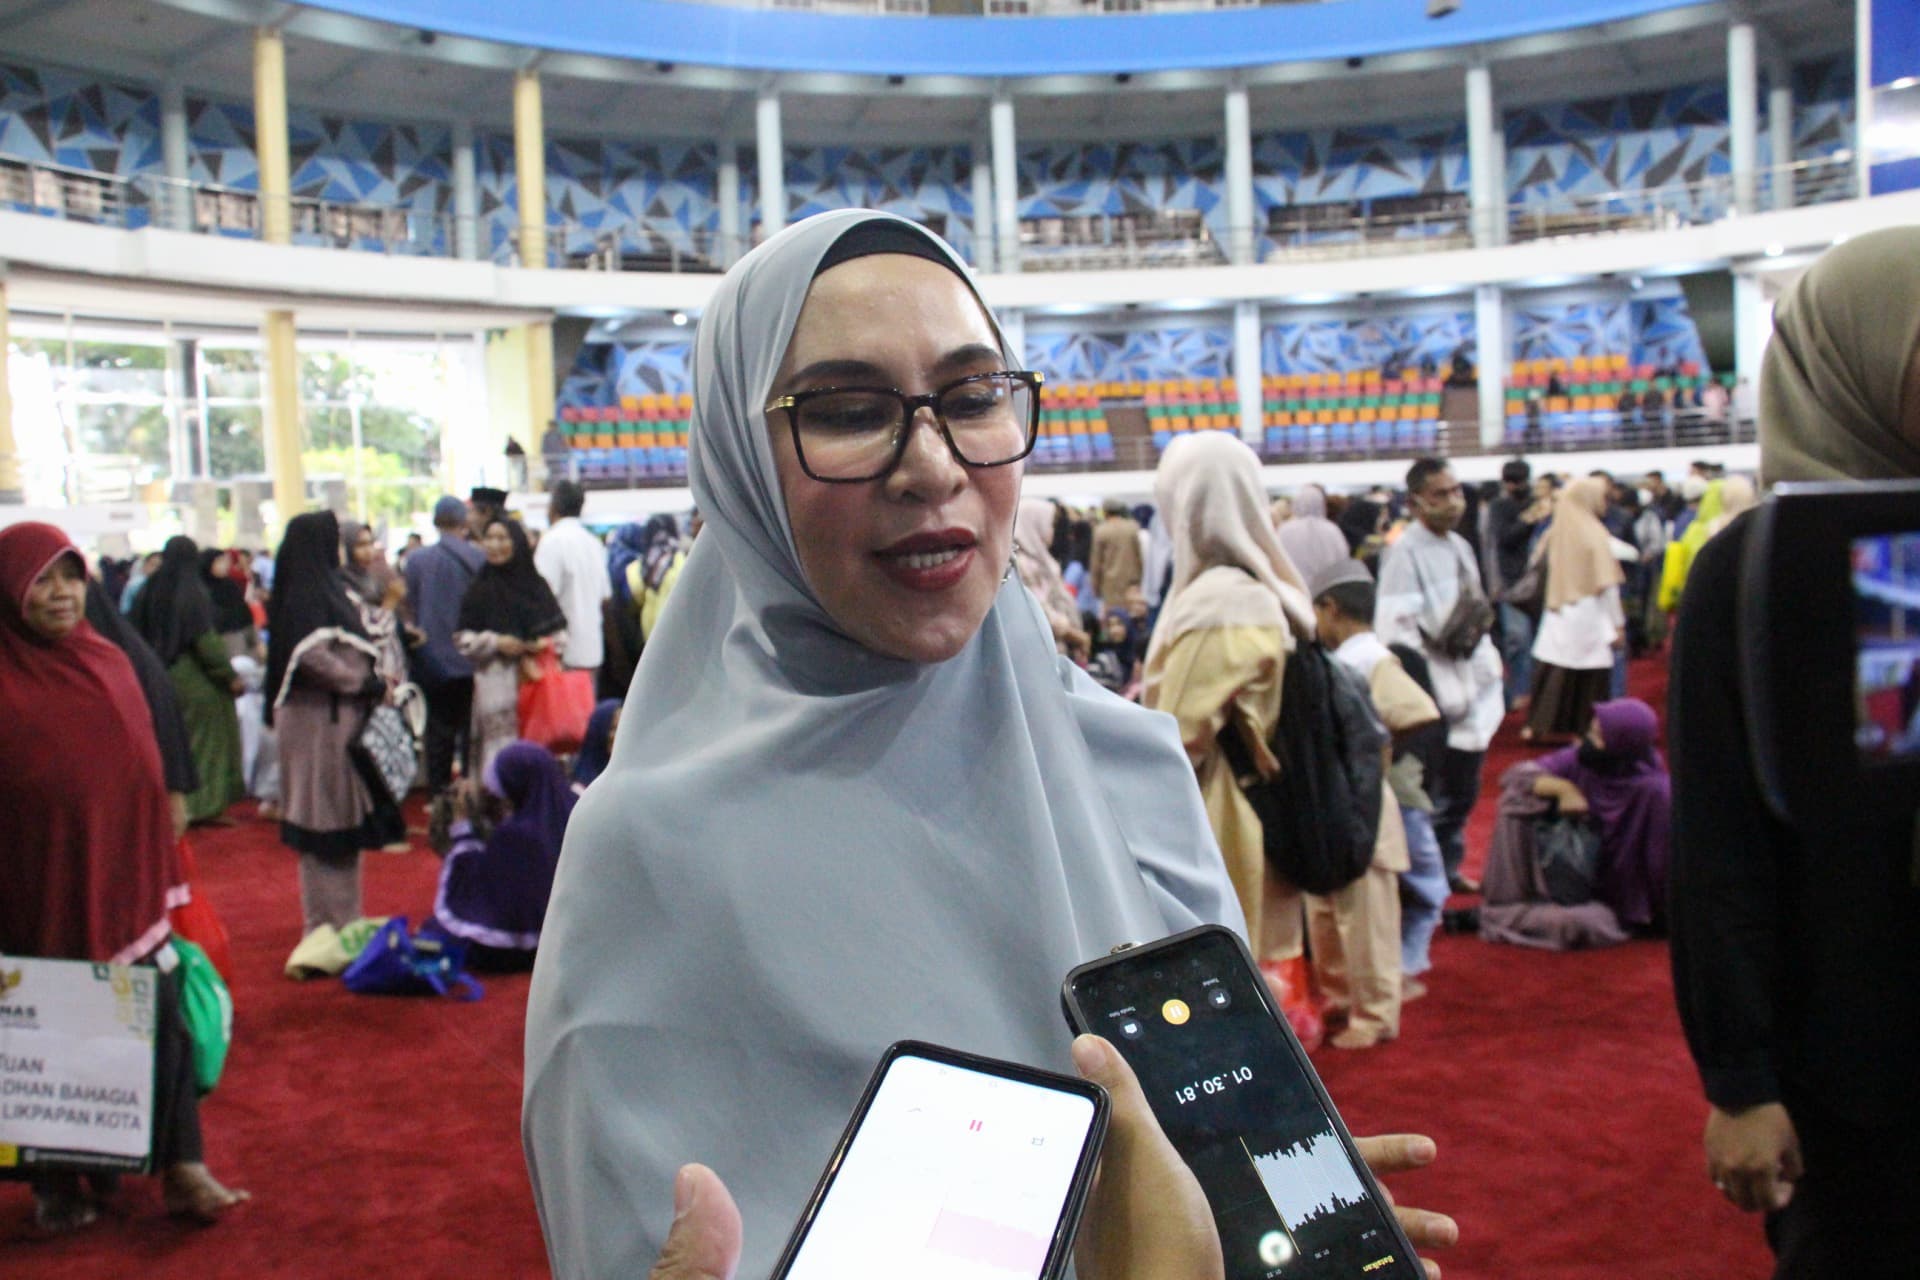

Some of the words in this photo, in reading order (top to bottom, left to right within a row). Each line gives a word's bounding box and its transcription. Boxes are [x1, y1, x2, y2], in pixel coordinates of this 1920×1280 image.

[0, 1079, 54, 1097] DHAN
[60, 1083, 139, 1105] BAHAGIA
[94, 1111, 142, 1130] KOTA
